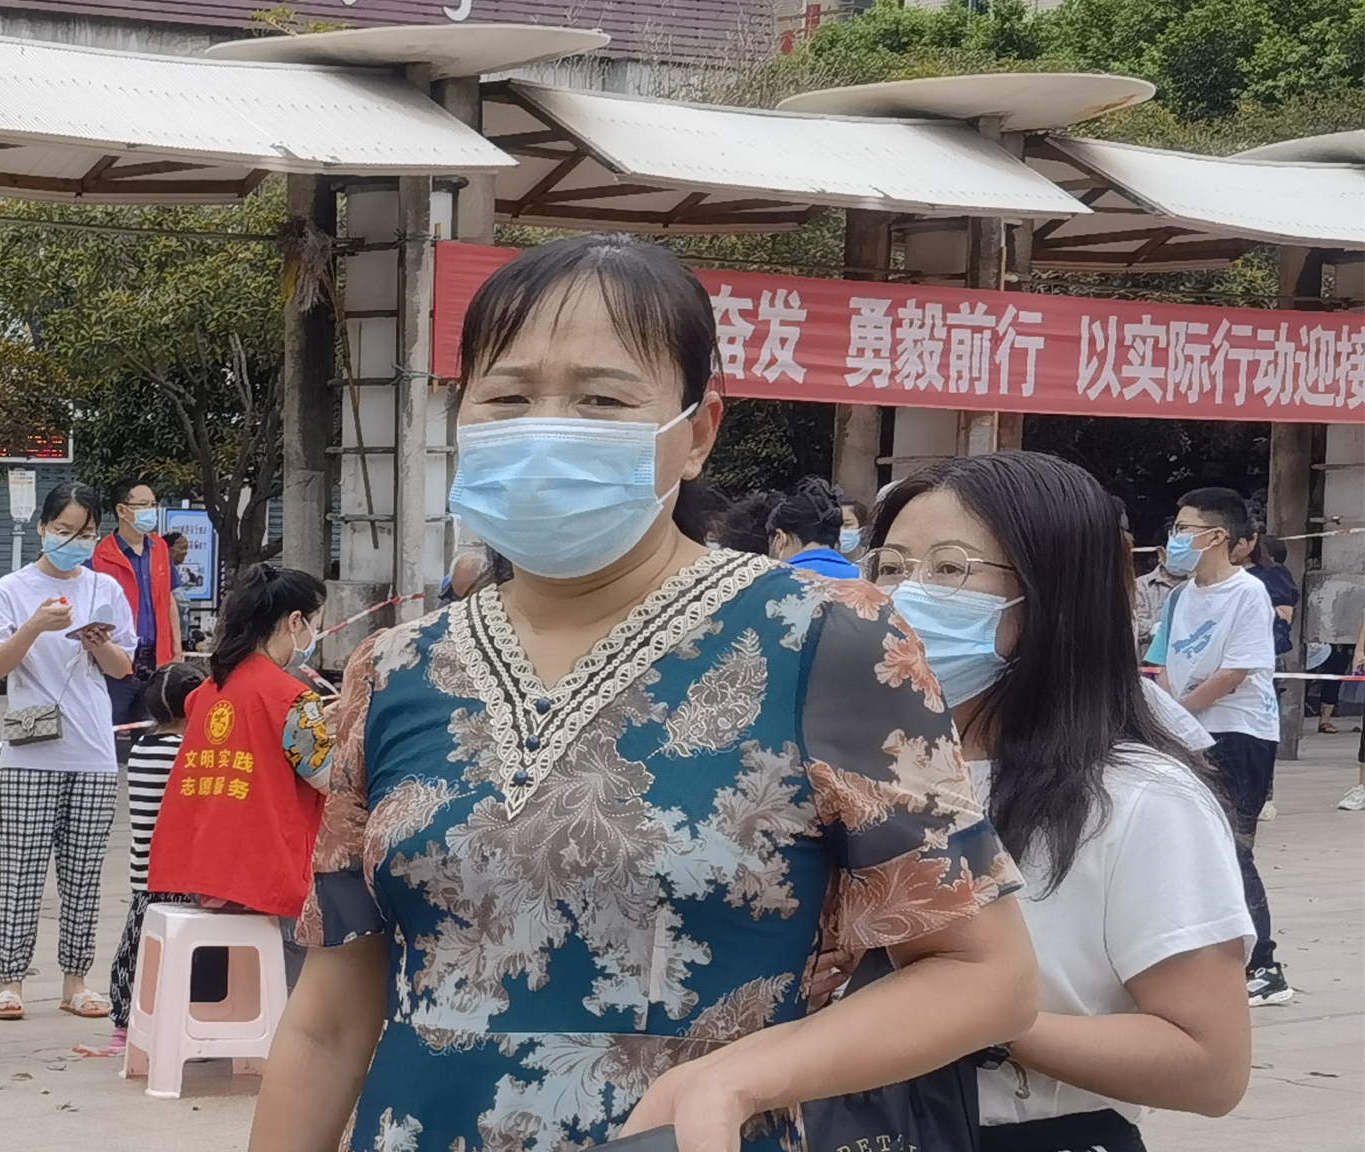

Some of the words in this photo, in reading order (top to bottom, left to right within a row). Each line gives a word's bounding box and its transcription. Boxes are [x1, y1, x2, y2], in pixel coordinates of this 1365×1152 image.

[844, 297, 1045, 397] 勇毅前行
[184, 748, 254, 773] 文明实践
[179, 776, 249, 800] 志愿服务
